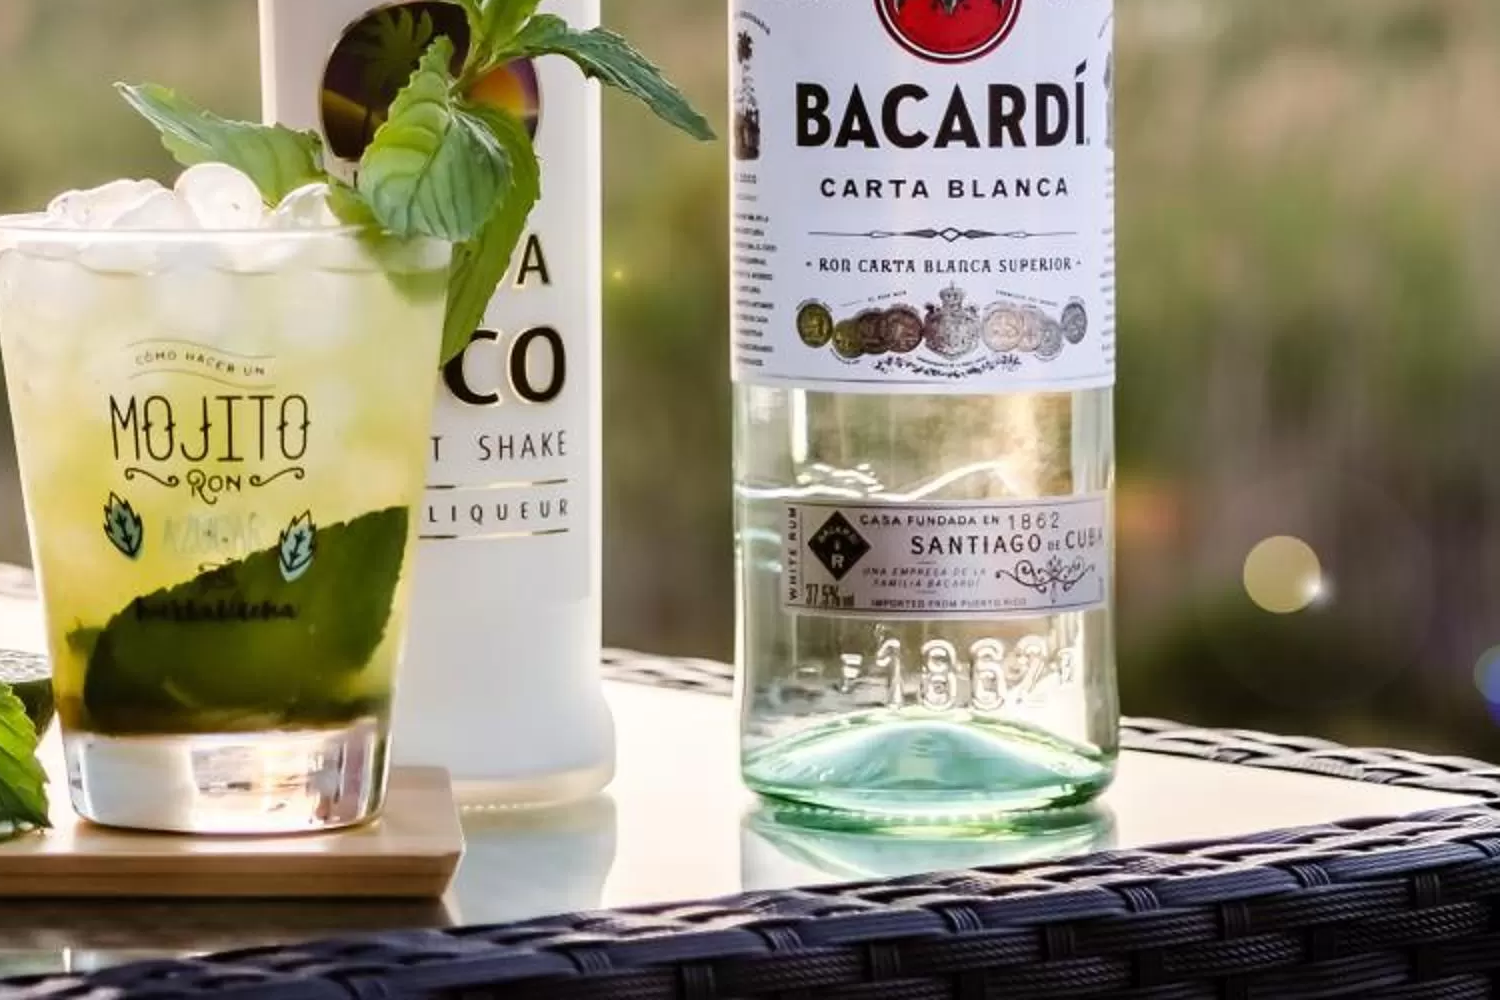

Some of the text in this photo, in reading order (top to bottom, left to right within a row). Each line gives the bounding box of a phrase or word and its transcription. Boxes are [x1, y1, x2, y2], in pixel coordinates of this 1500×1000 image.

[796, 59, 1088, 149] BACARDÍ
[820, 177, 1070, 199] CARTA BLANCA
[818, 257, 1073, 274] RON CARTA BLANCA SUPERIOR
[243, 365, 265, 377] UN
[108, 395, 311, 463] MOJITO
[477, 429, 567, 462] SHAKE
[428, 498, 569, 524] LIQUEUR
[859, 511, 1060, 530] CASA FUNDADA EN 1862
[787, 506, 798, 601] WHITE RUM
[910, 533, 1042, 556] SANTIAGO
[1047, 539, 1060, 551] DE
[871, 599, 925, 609] IMPORTED
[928, 600, 957, 608] FROM
